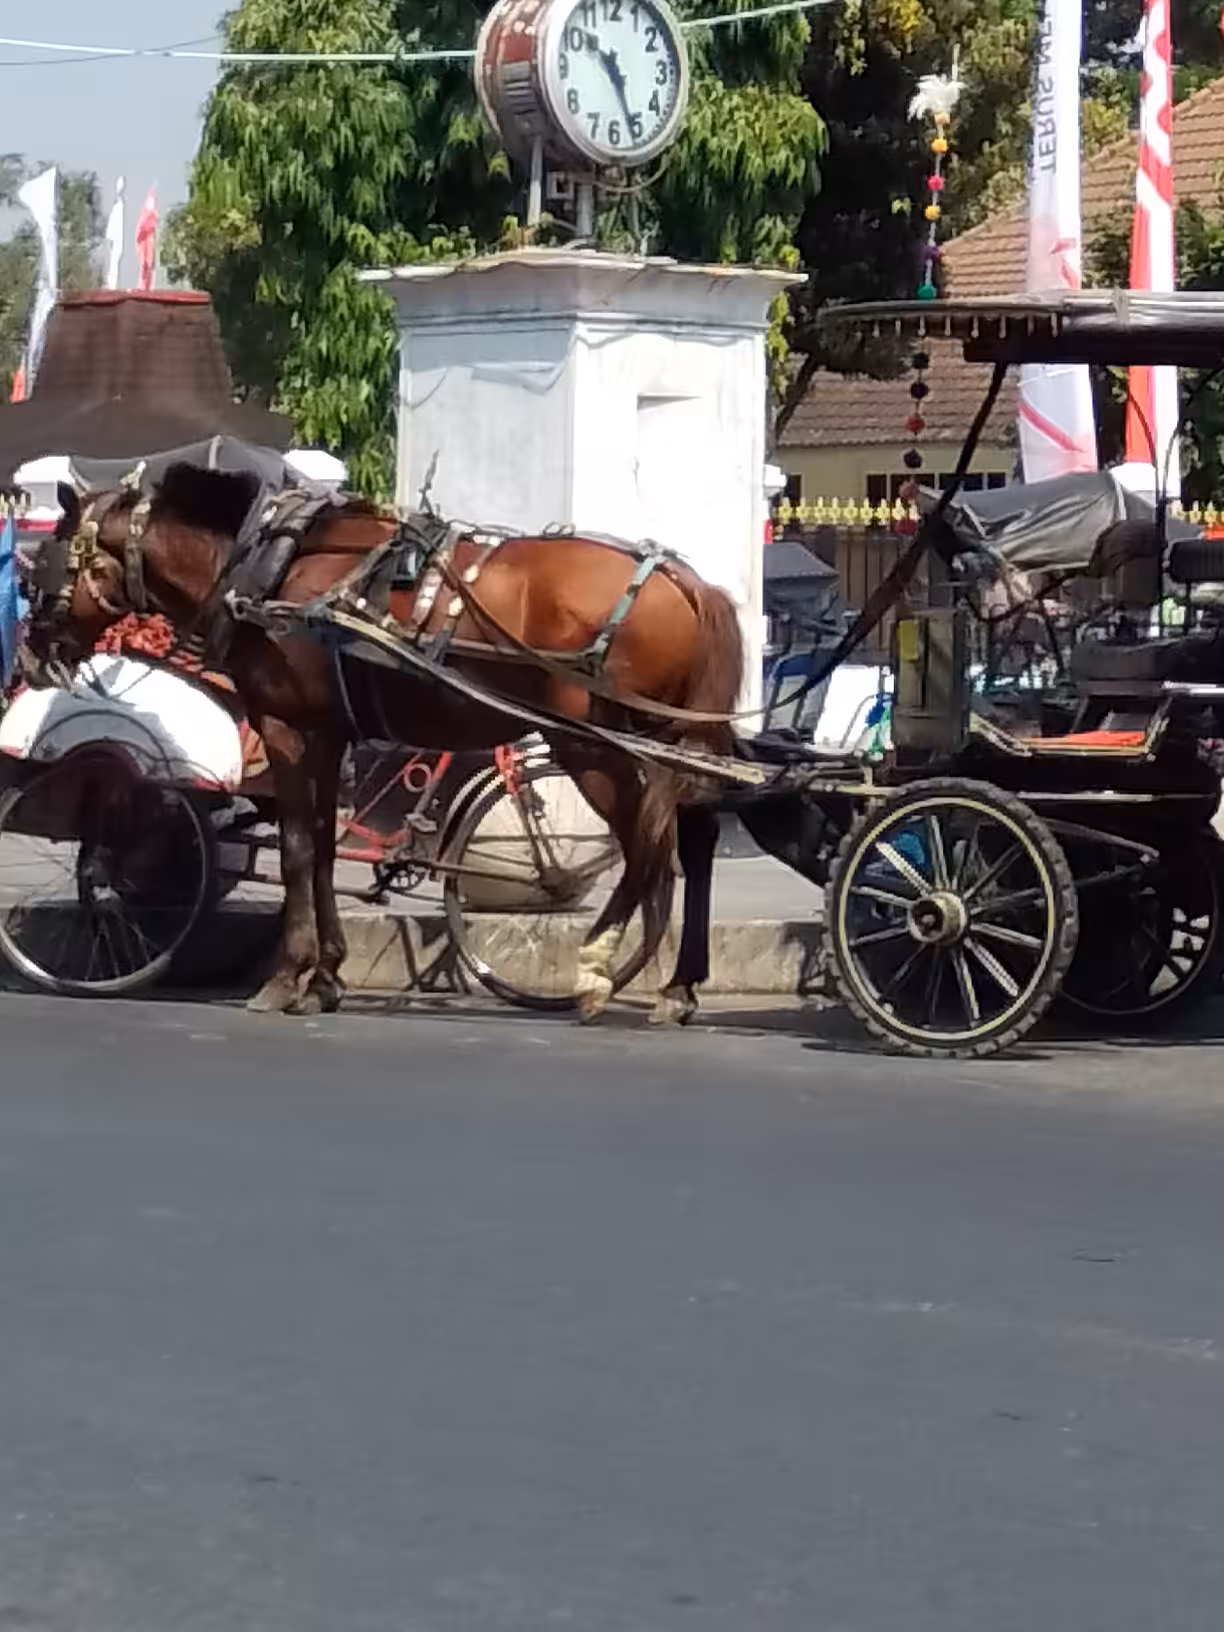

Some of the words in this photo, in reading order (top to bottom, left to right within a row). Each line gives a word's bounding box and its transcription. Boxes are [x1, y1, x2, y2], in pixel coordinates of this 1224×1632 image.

[583, 2, 598, 28] 11
[630, 7, 640, 32] 1
[645, 27, 658, 53] 2
[558, 55, 569, 80] 9
[655, 61, 668, 86] 3
[567, 89, 580, 115] 8
[648, 90, 661, 118] 4
[587, 112, 600, 140] 7
[608, 120, 622, 146] 6
[632, 112, 643, 139] 5
